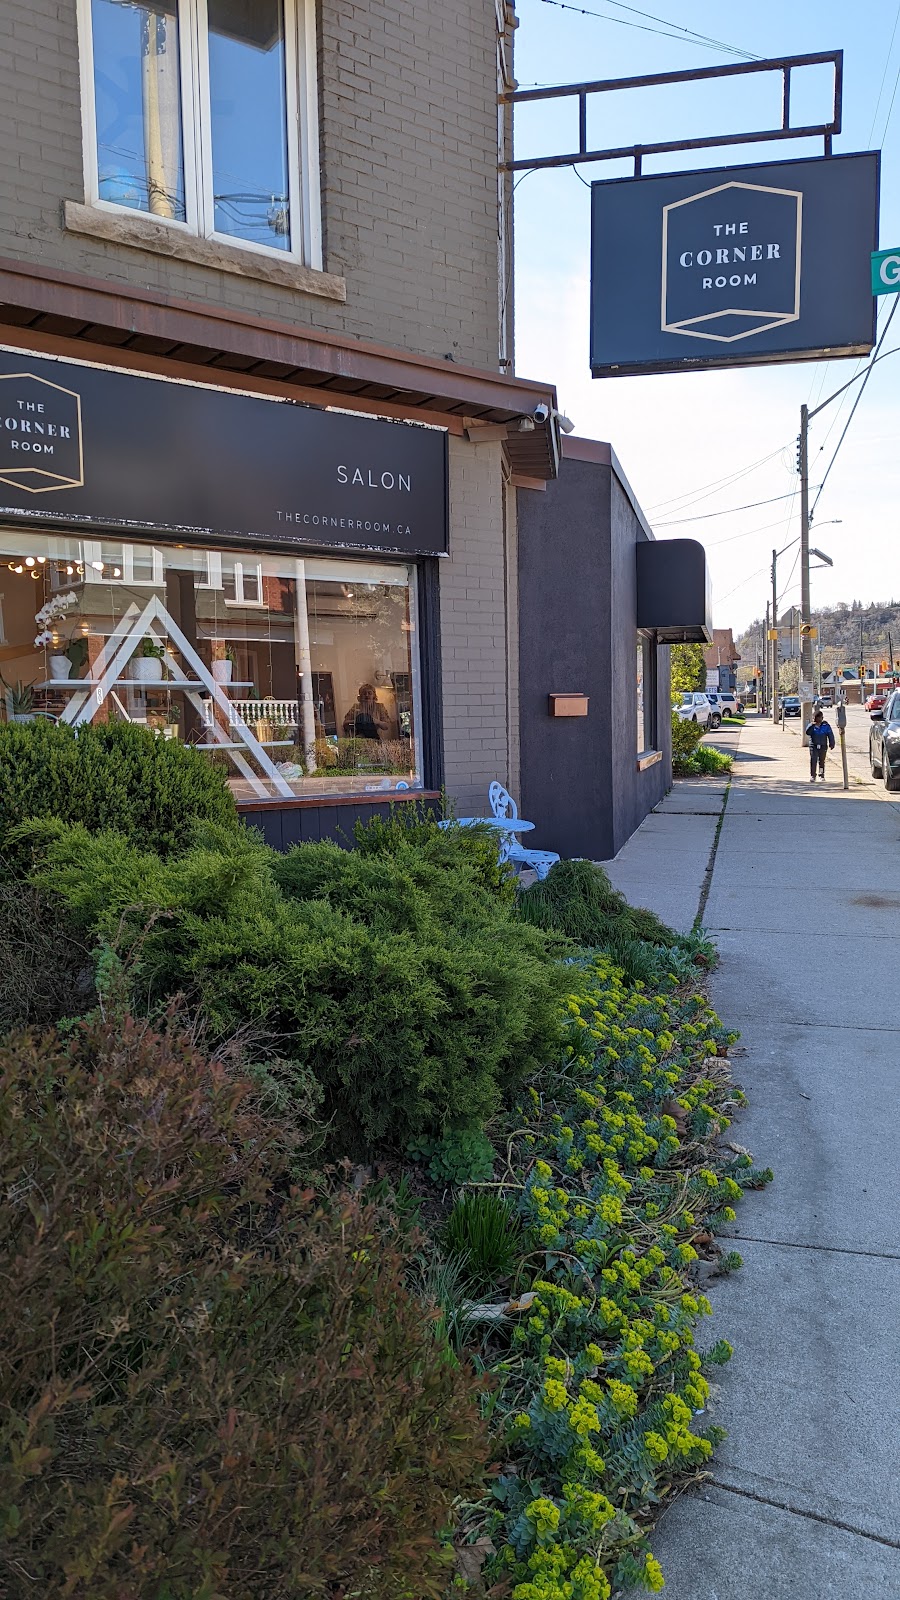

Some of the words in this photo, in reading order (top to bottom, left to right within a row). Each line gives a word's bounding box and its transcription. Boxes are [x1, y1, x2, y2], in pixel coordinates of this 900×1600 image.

[713, 222, 748, 236] THE
[679, 243, 781, 267] CORNER
[702, 273, 757, 289] ROOM
[16, 400, 45, 413] THE
[0, 417, 71, 439] ORNER
[11, 440, 54, 454] ROOM
[337, 465, 411, 492] SALON
[276, 511, 411, 534] THECORNERROOM.CA
